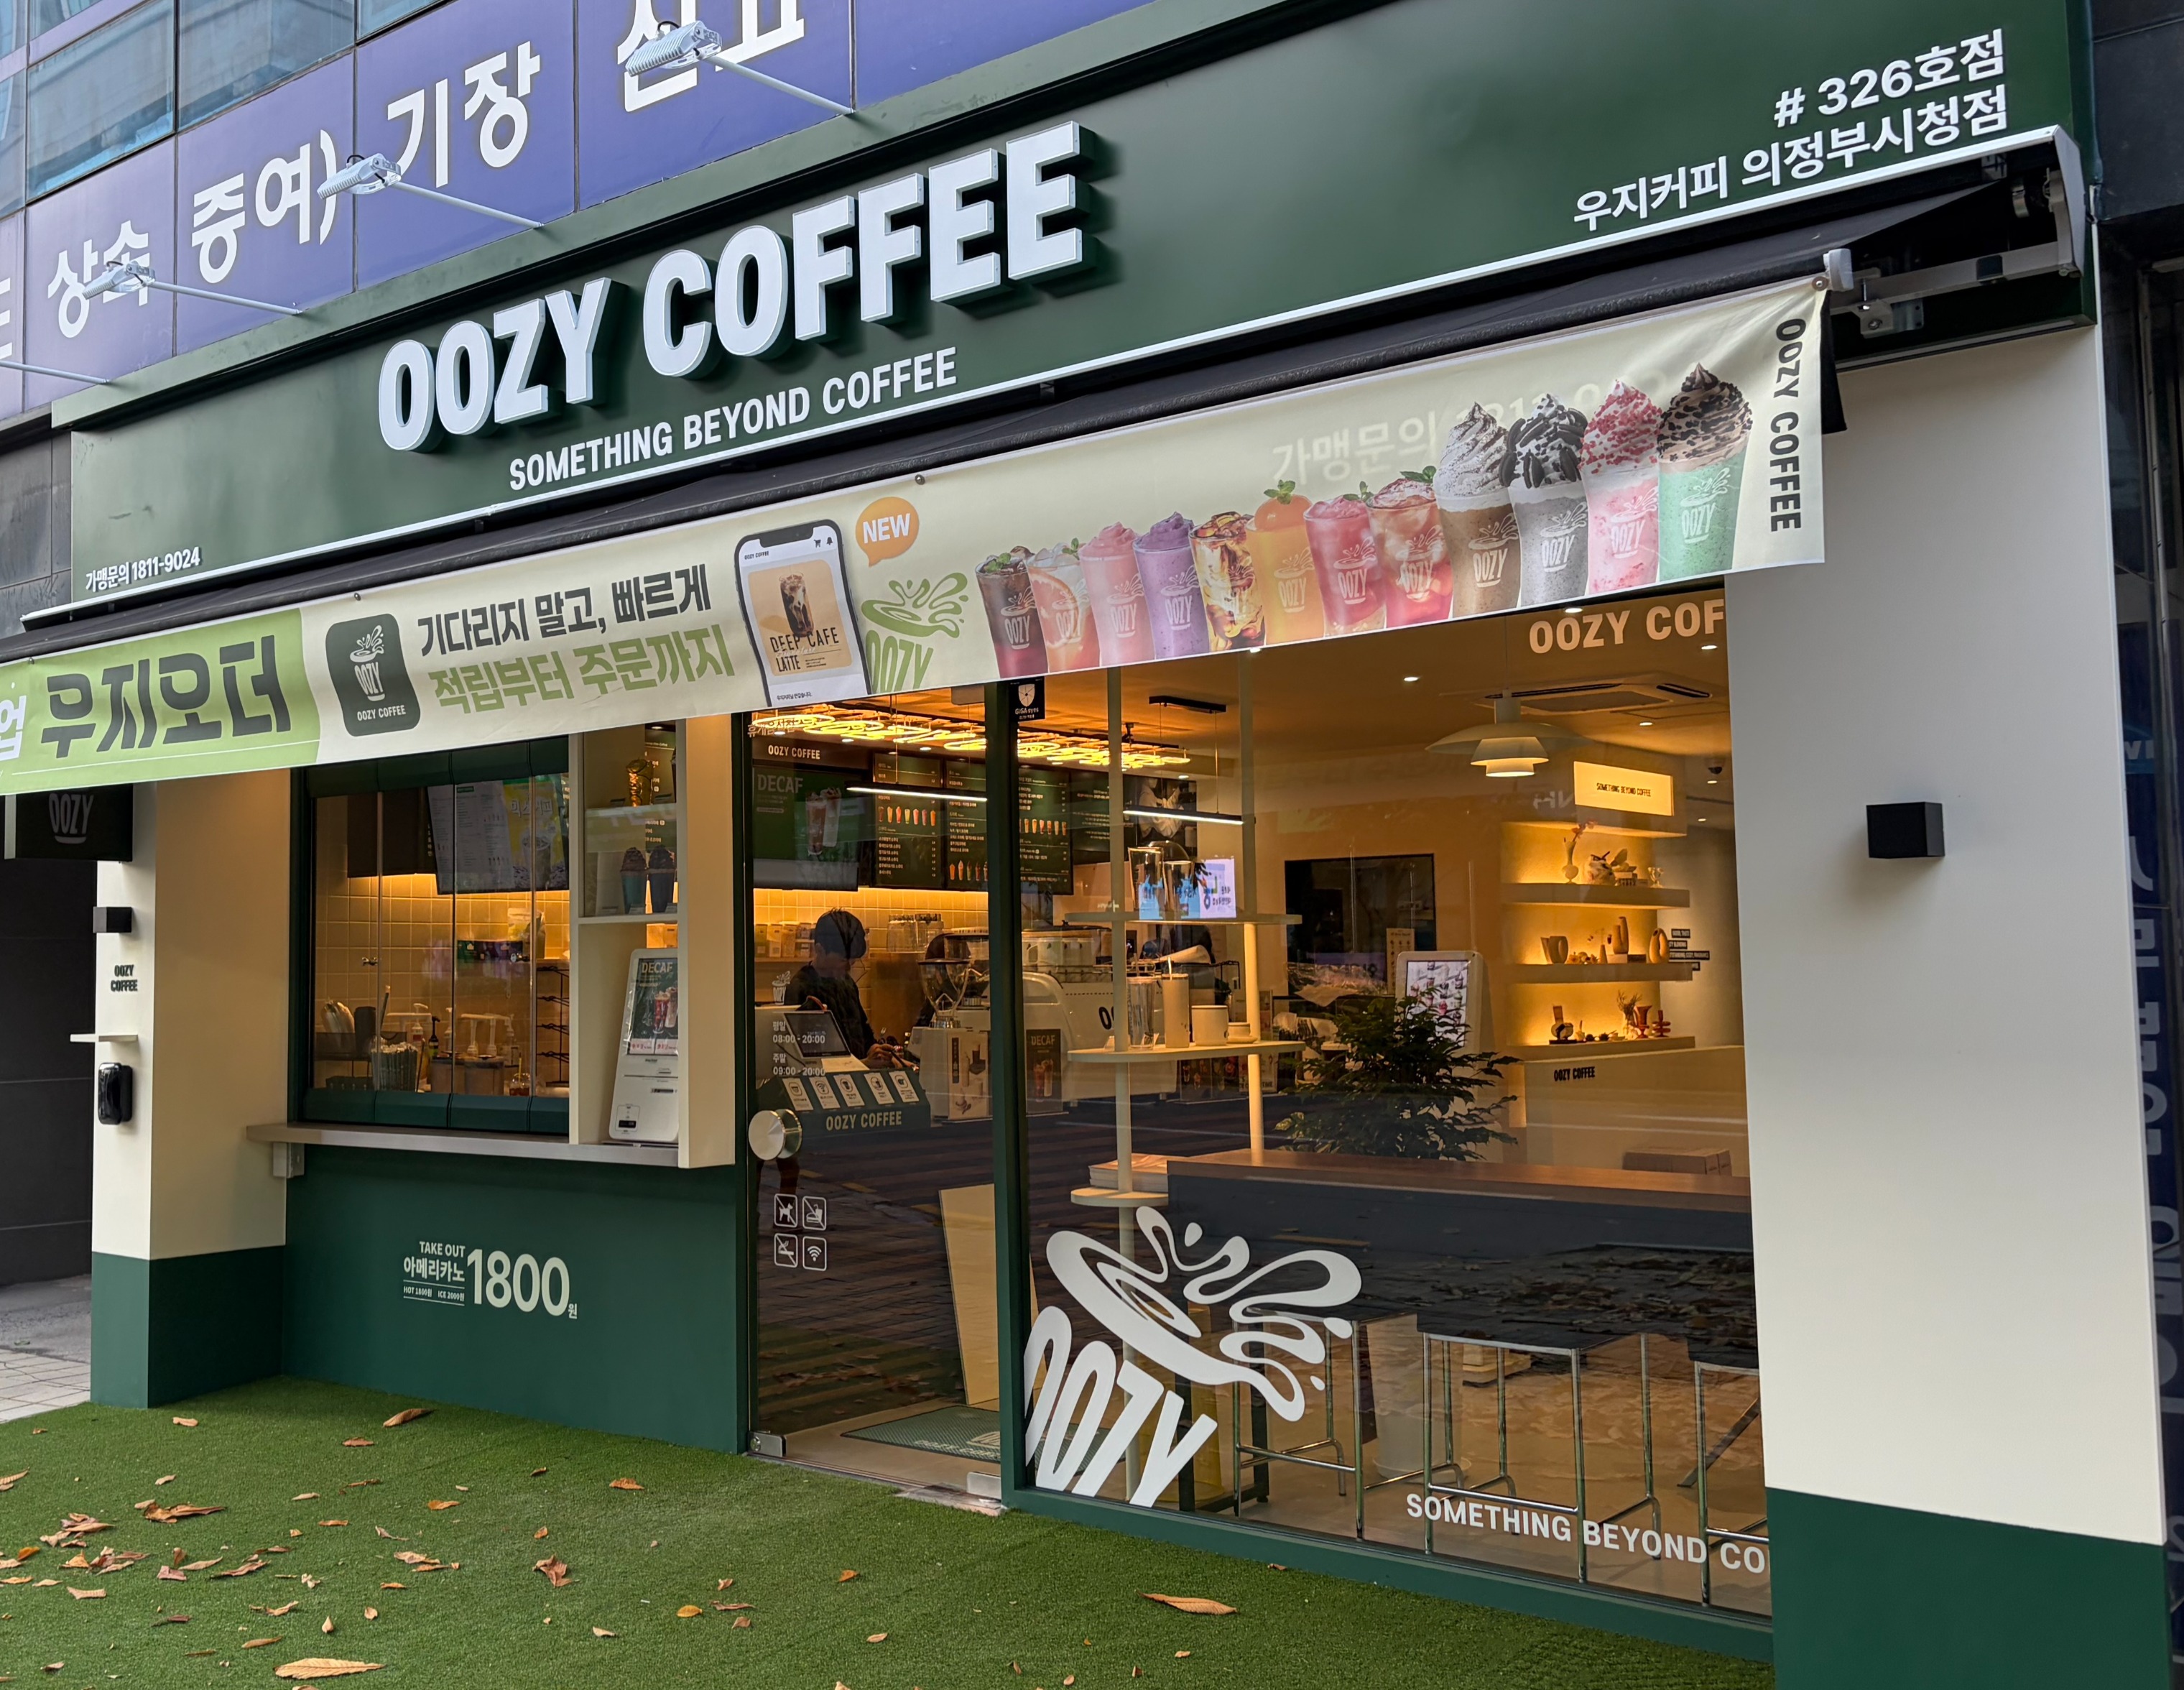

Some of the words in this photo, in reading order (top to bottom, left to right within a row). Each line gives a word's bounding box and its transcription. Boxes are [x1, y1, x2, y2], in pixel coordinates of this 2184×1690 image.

[1773, 87, 1806, 129] #
[1817, 29, 2004, 116] 326호점
[388, 41, 540, 188] 기장
[1573, 156, 1728, 232] 우지커피
[1741, 85, 2008, 187] 의정부시청점
[378, 277, 612, 451] OOZY
[643, 120, 1083, 377] COFFEE
[1772, 318, 1807, 400] OOZY
[509, 420, 673, 491] SOMETHING
[682, 387, 810, 451] BEYOND
[823, 346, 958, 415] COFFEE
[1769, 411, 1804, 532] COFFEE
[862, 513, 911, 544] NEW
[1680, 502, 1717, 538] OOZY
[1541, 535, 1575, 567] OOZY
[1611, 520, 1647, 553] OOZY
[85, 561, 130, 593] 가맹문의
[131, 546, 201, 581] 1811-9024
[1472, 548, 1508, 582] OOZY
[1337, 568, 1368, 599] OOZY
[417, 598, 530, 657] 기다리지
[535, 587, 606, 639] 말고,
[611, 564, 711, 624] 빠르게
[1165, 594, 1193, 624] OOZY
[769, 633, 801, 653] DEEP
[806, 627, 840, 648] CAFE
[1004, 615, 1030, 645] OOZY
[1529, 609, 1632, 655] OOZY
[1645, 597, 1725, 641] COF
[353, 661, 384, 694] OOZY
[428, 650, 575, 715] 적립부터
[573, 624, 735, 696] 주문까지
[776, 654, 801, 673] LATTE
[41, 635, 292, 759] 우지오더
[356, 708, 376, 721] OOZY
[378, 705, 407, 718] COFFEE
[768, 744, 789, 756] OOZY
[791, 746, 820, 760] COFFEE
[757, 774, 804, 794] DECAF
[49, 793, 95, 835] OOZY
[114, 964, 135, 977] OOZY
[641, 961, 673, 974] DECAF
[110, 979, 139, 992] COFFEE
[772, 1020, 787, 1032] 평일
[772, 1034, 796, 1044] 08:00
[802, 1034, 826, 1044] 20:00
[1031, 1035, 1056, 1046] DECAF
[772, 1053, 787, 1064] 주말
[772, 1066, 796, 1076] 09:00
[802, 1067, 826, 1077] 20:00
[1553, 1068, 1571, 1082] OOZY
[1572, 1066, 1596, 1079] COFFEE
[825, 1114, 857, 1131] OOZY
[861, 1111, 902, 1129] COFFEE
[420, 1241, 443, 1256] TAKE
[445, 1244, 466, 1258] OUT
[403, 1256, 466, 1283] 아메리카노
[403, 1285, 415, 1295] HOT
[438, 1290, 446, 1298] ICE
[1406, 1493, 1571, 1542] SOMETHING
[1583, 1520, 1708, 1564] BEYOND
[1720, 1542, 1769, 1575] CO
